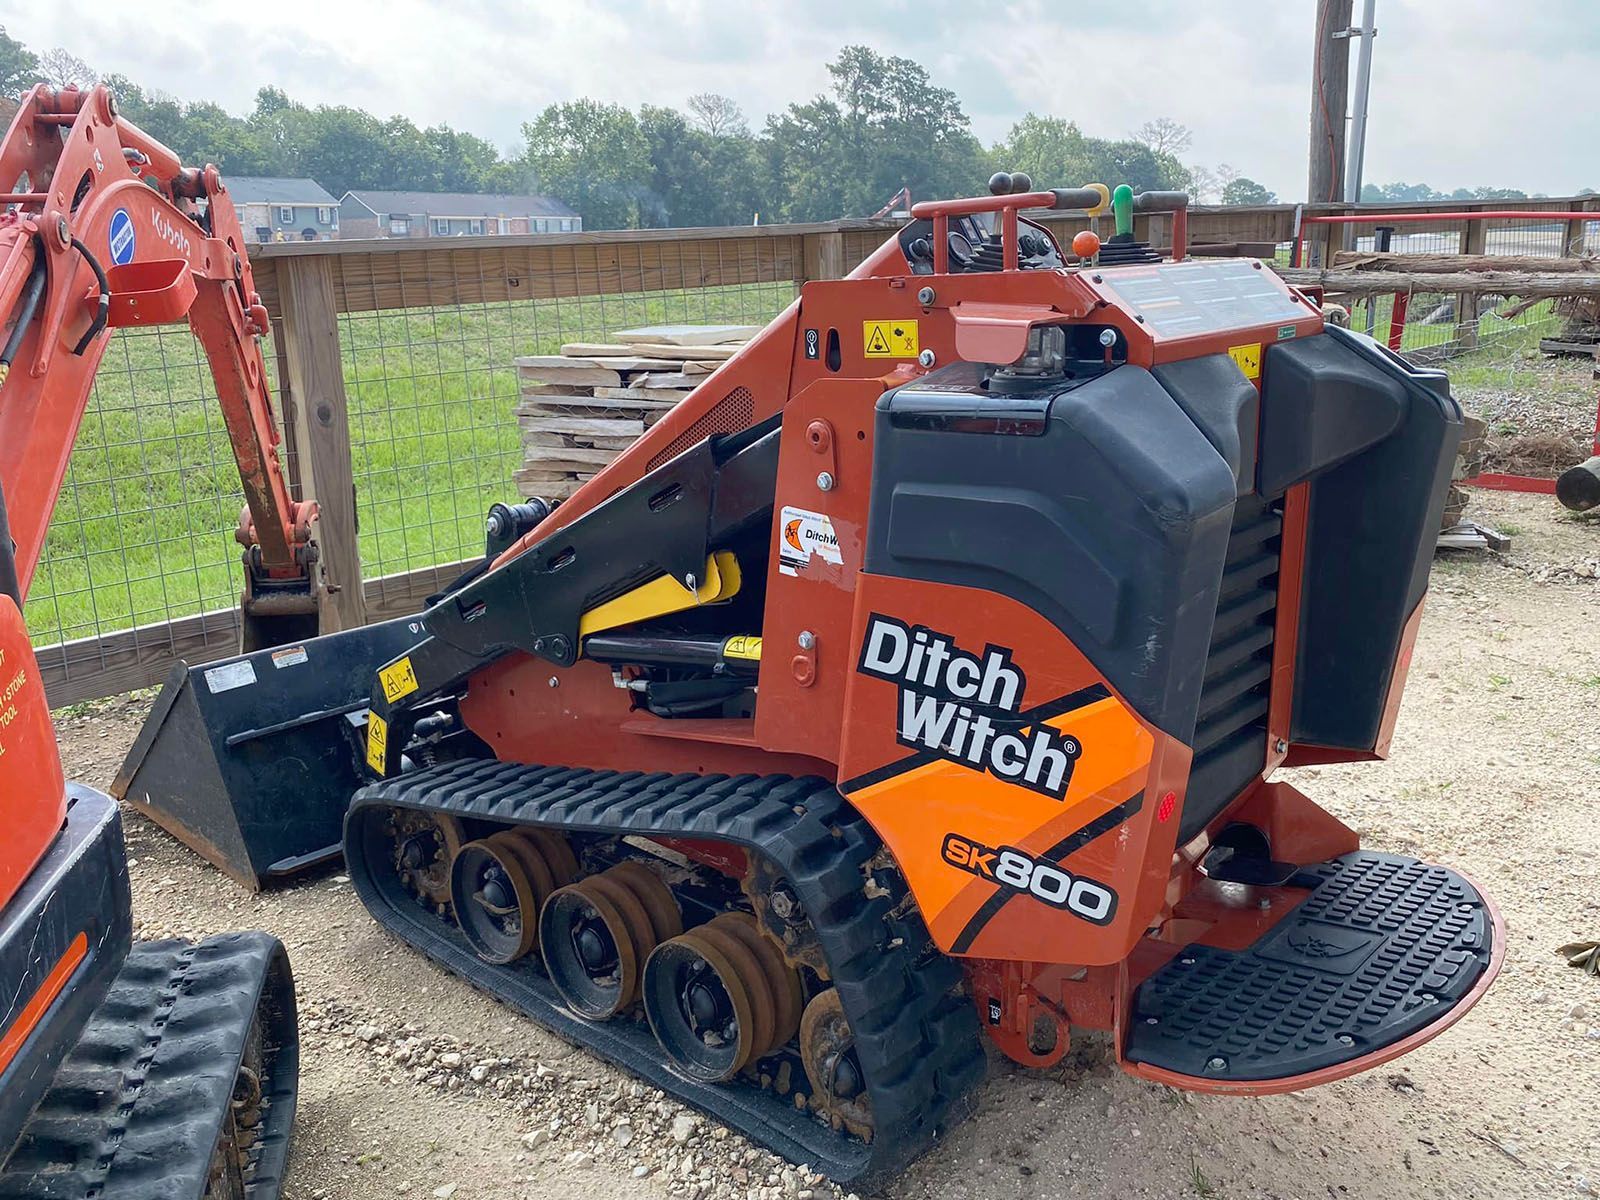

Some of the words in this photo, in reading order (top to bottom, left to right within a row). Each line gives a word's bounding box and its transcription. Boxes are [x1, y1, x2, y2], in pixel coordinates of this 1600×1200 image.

[152, 206, 191, 257] Kubota
[806, 529, 840, 546] DitchW
[863, 620, 1019, 711] Ditch
[0, 704, 18, 729] TOOL
[945, 838, 1112, 920] SK800
